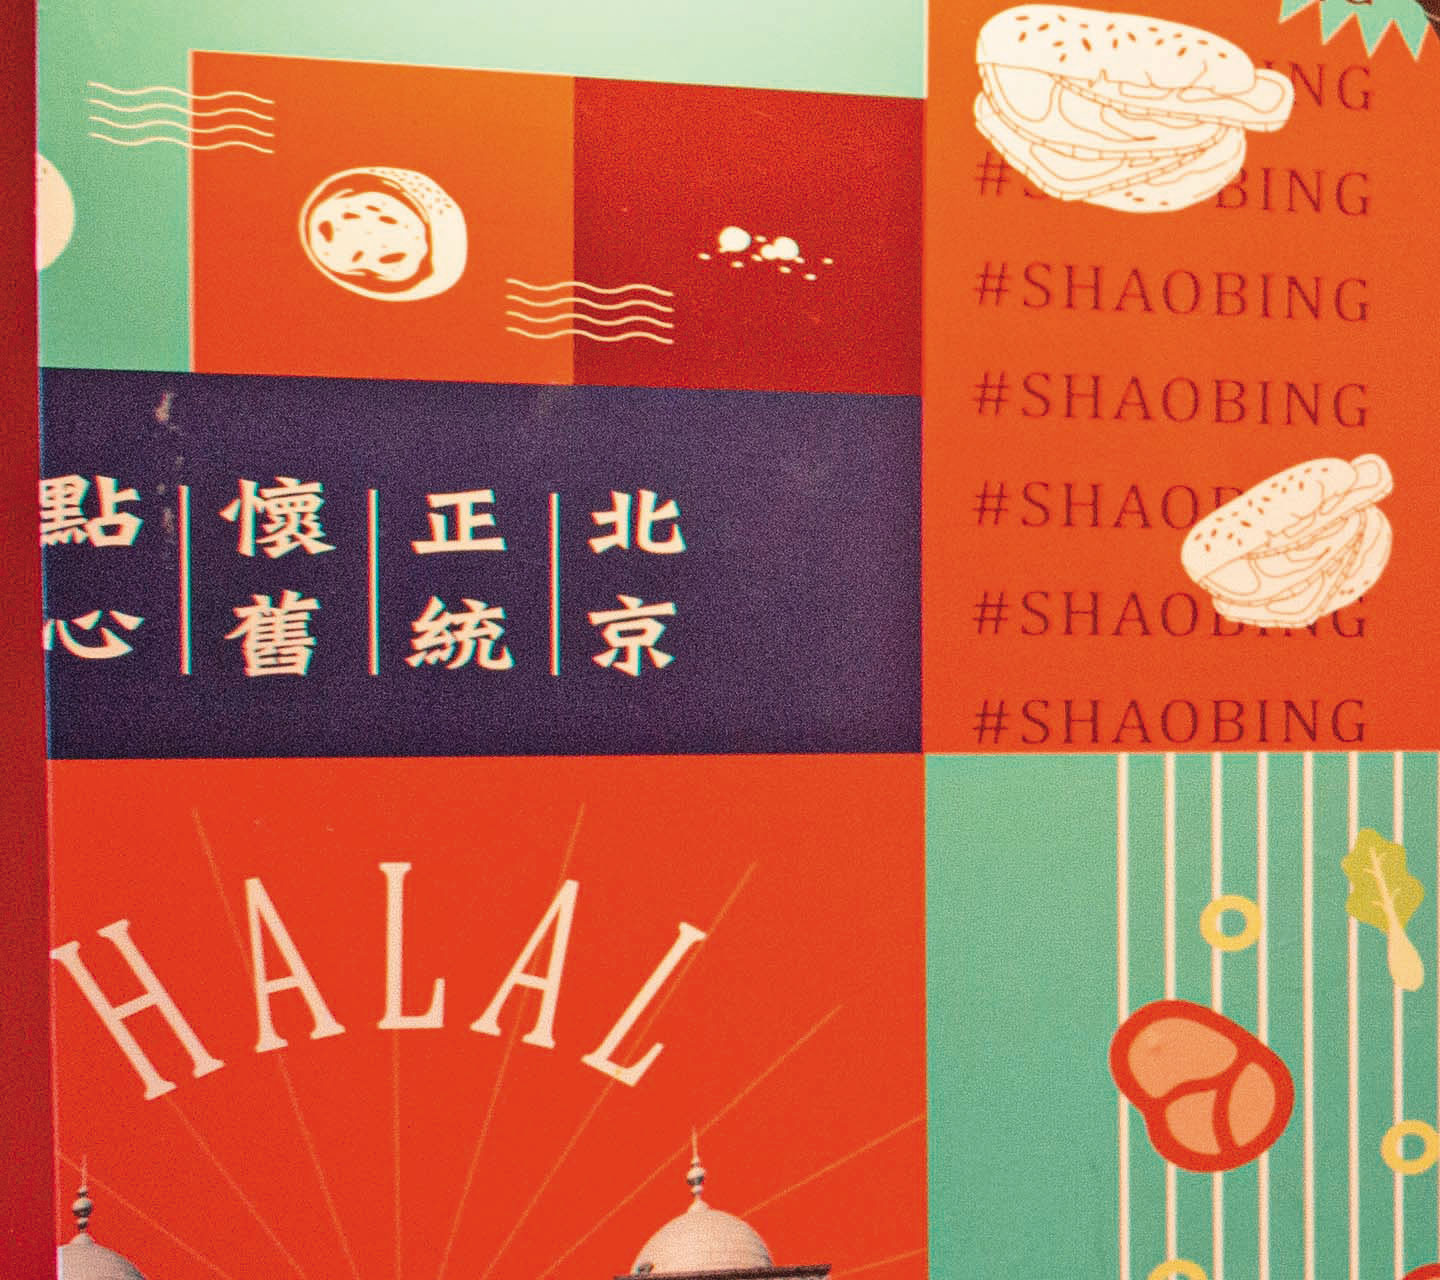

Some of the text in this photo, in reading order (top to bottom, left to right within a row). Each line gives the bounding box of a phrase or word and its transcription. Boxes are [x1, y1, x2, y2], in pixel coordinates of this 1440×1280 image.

[974, 262, 1371, 322] #SHAOBING
[974, 370, 1370, 429] #SHAOBING
[38, 474, 145, 661] 點心
[219, 475, 337, 678] 懷舊
[405, 488, 515, 672] 正統
[588, 488, 686, 676] 北京
[973, 480, 1240, 531] #SHAO
[973, 697, 1368, 746] #SHAOBING
[50, 861, 706, 1101] HALAL
